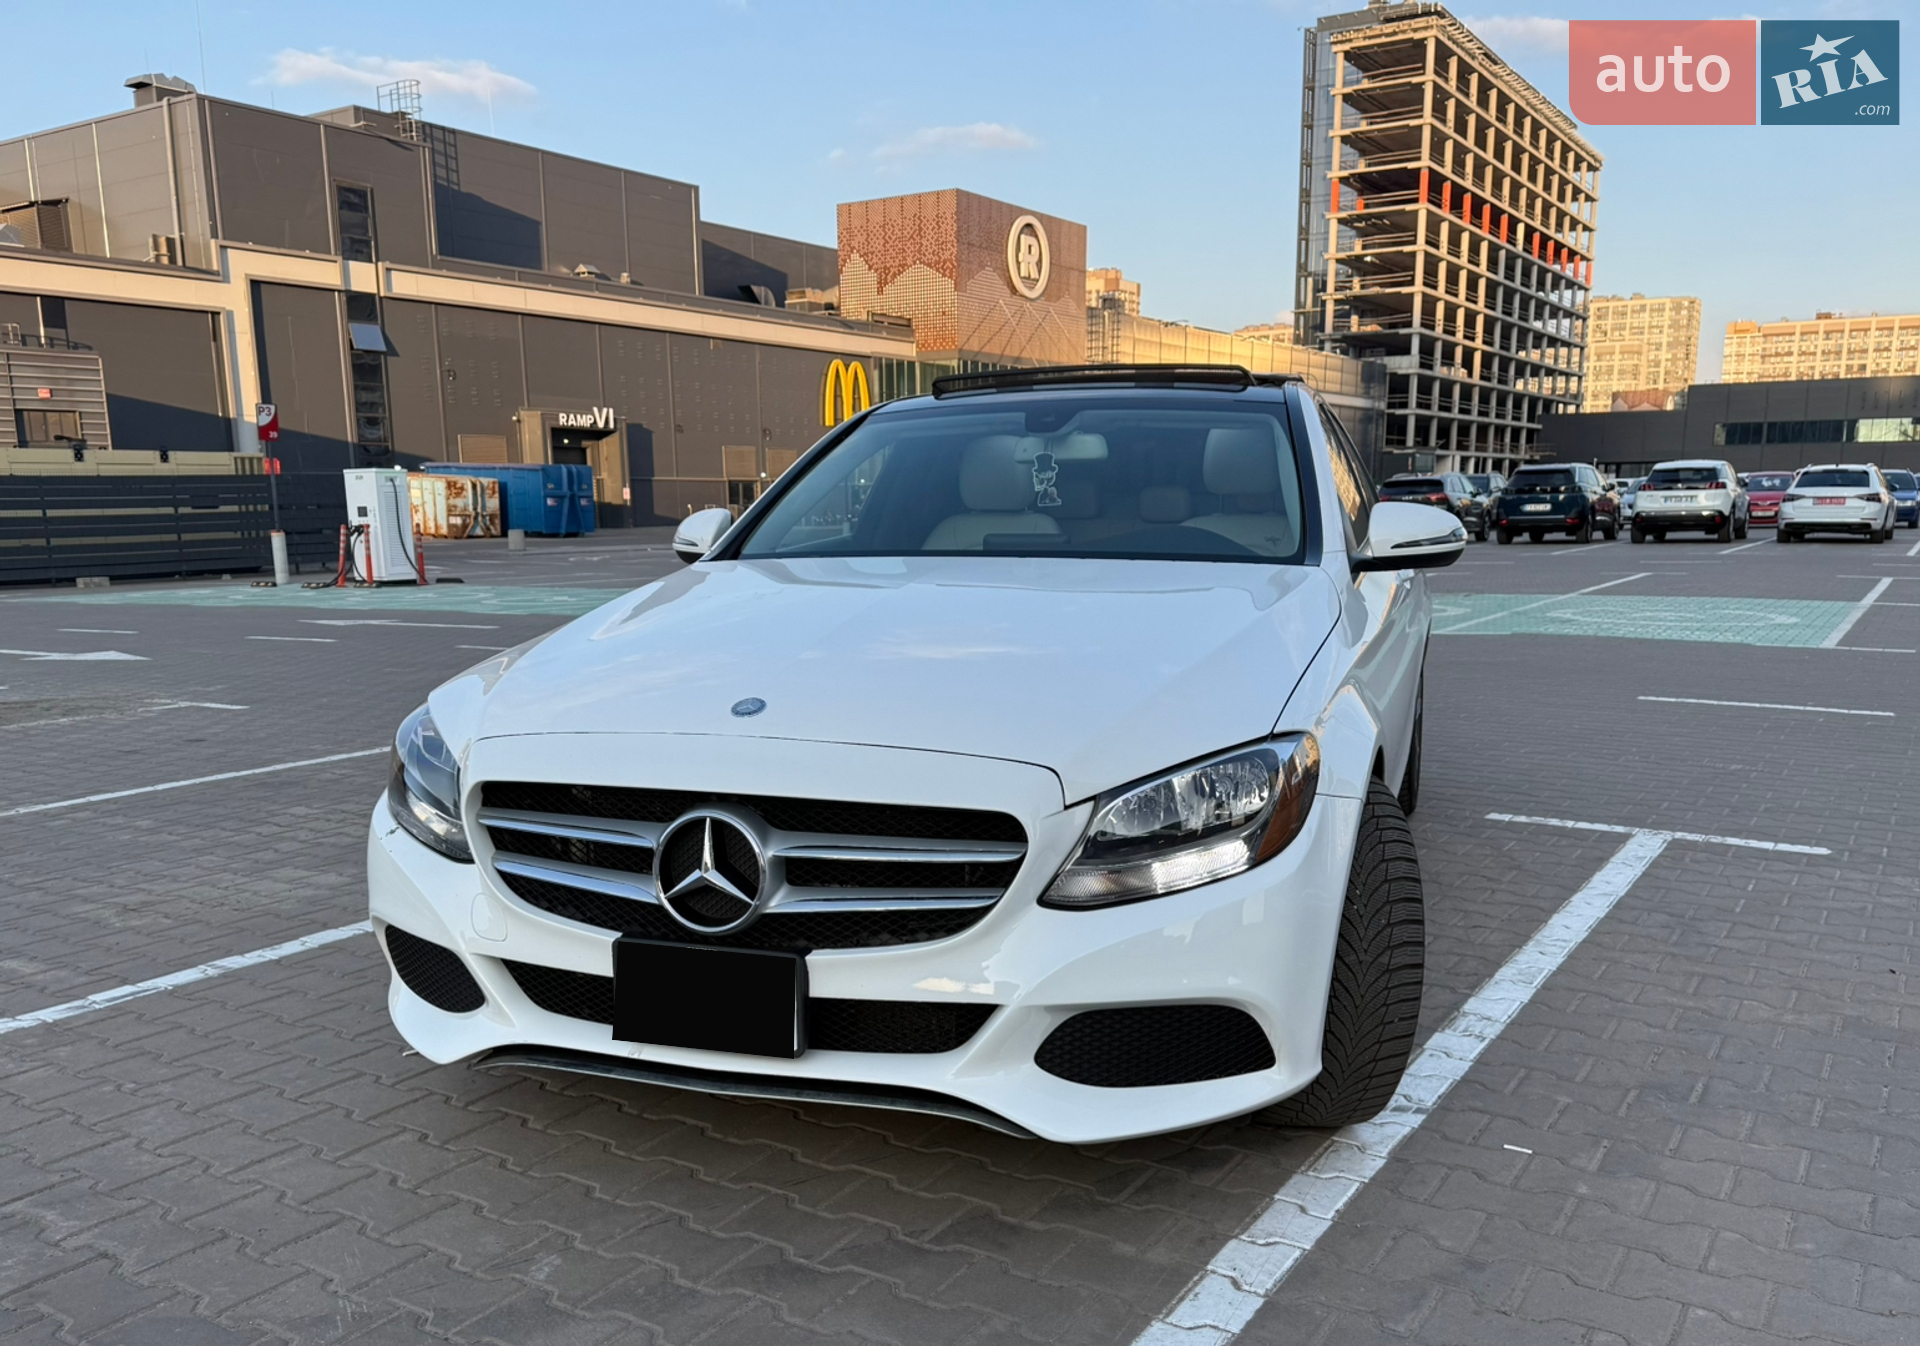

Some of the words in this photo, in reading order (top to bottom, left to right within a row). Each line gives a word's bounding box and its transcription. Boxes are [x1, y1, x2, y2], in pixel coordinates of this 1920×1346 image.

[258, 406, 272, 417] P3
[559, 412, 595, 428] RAMP
[592, 406, 615, 430] VI
